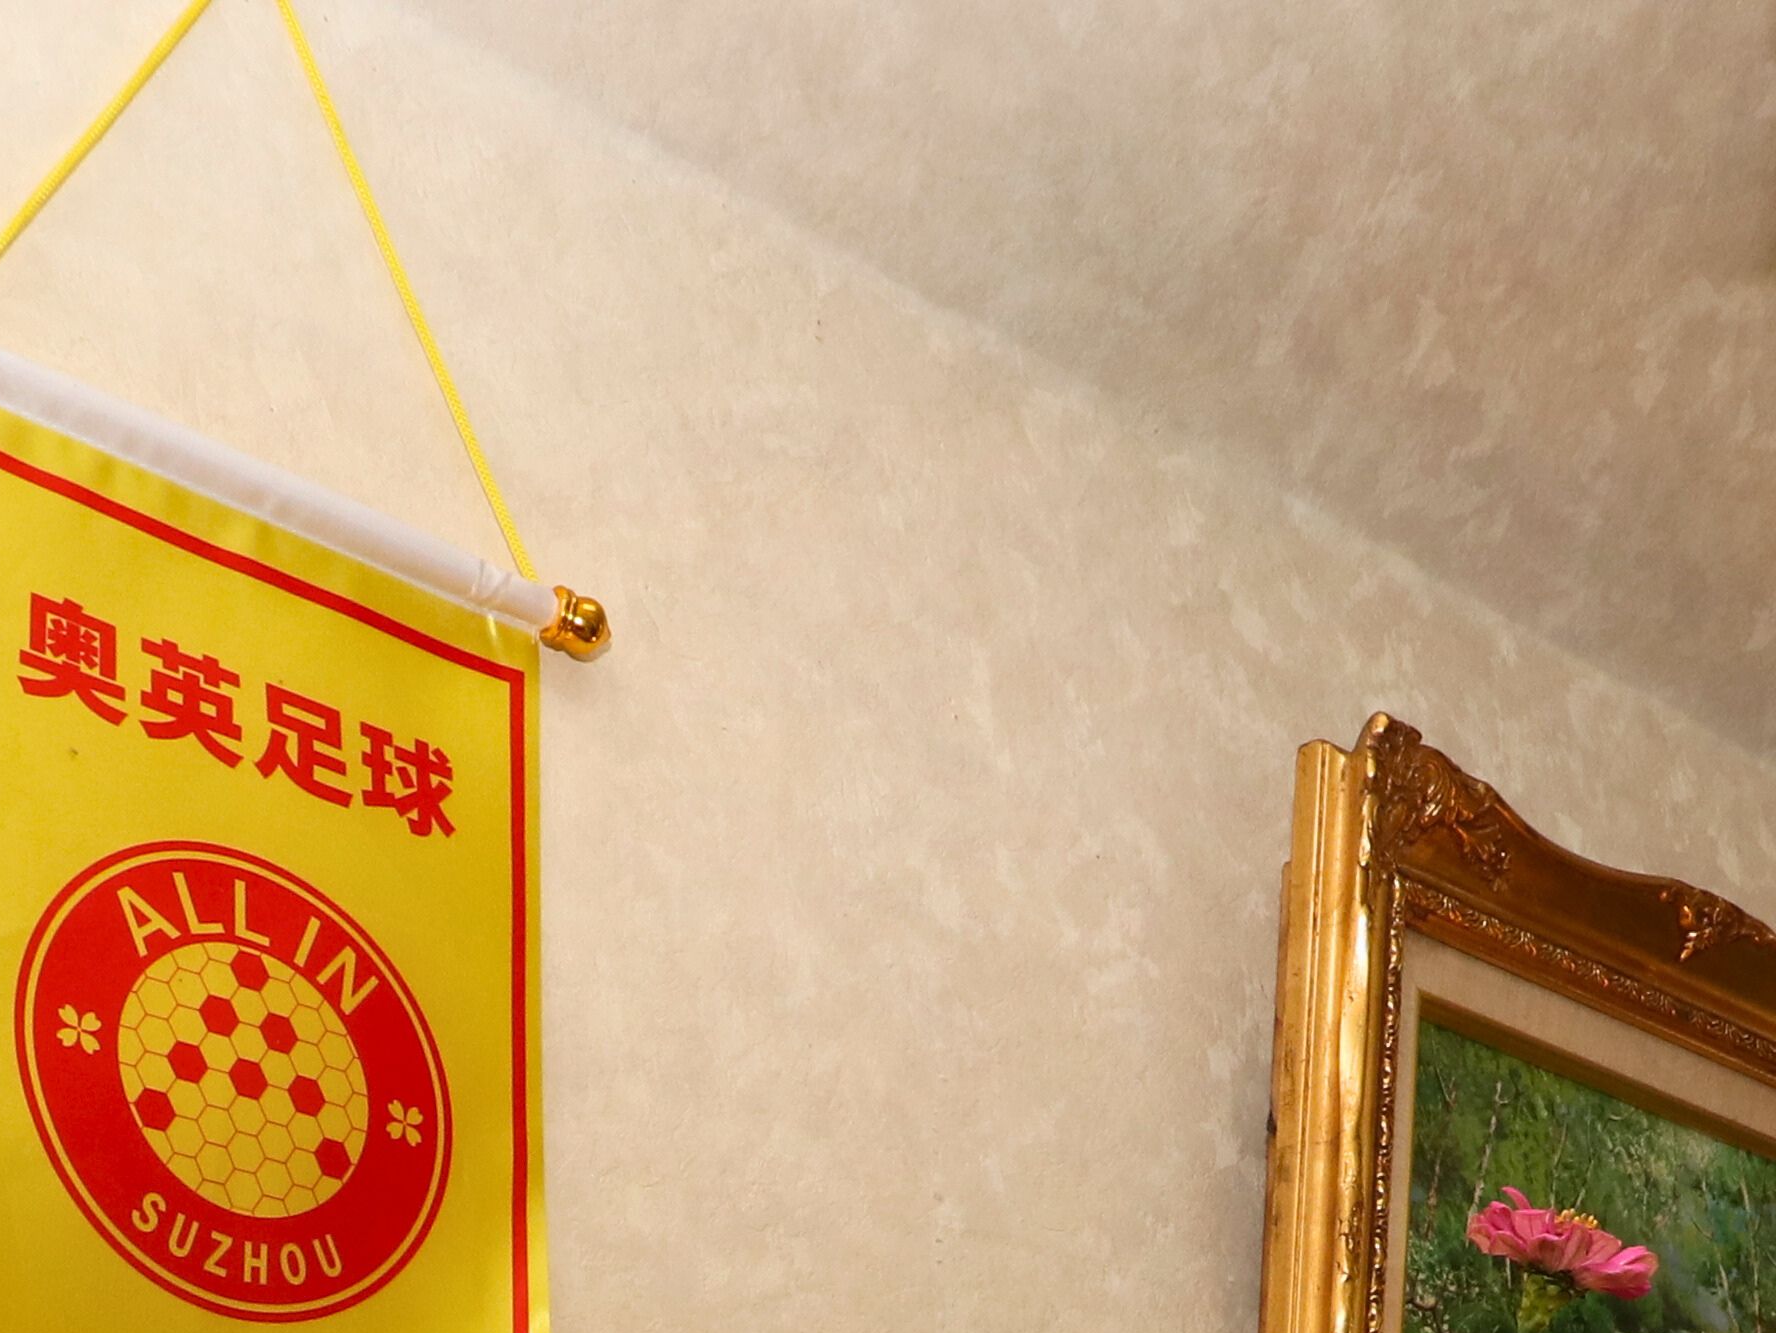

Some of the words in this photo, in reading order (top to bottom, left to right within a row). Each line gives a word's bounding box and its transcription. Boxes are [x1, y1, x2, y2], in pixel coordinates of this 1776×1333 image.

[16, 592, 457, 839] 奥英足球
[114, 870, 271, 956] ALL
[290, 915, 381, 1018] IN
[130, 1191, 344, 1287] SUZHOU
